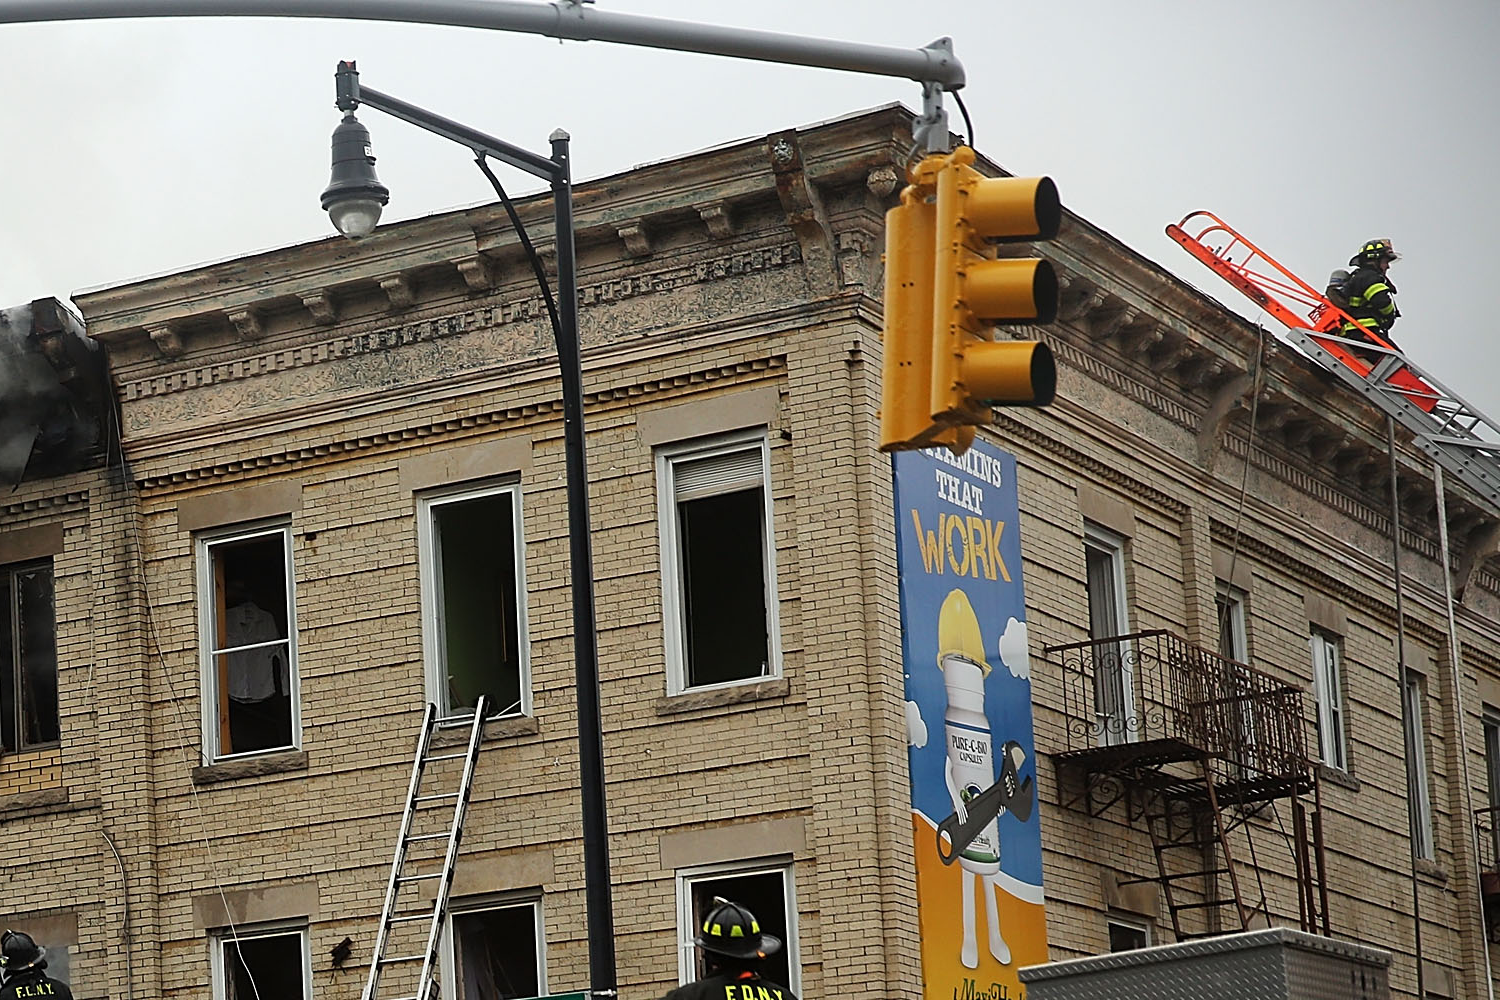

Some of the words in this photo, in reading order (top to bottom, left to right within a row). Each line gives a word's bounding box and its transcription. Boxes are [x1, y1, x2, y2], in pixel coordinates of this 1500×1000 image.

[935, 468, 983, 516] THAT
[911, 508, 1012, 582] WORK
[959, 752, 983, 765] CAPSULES
